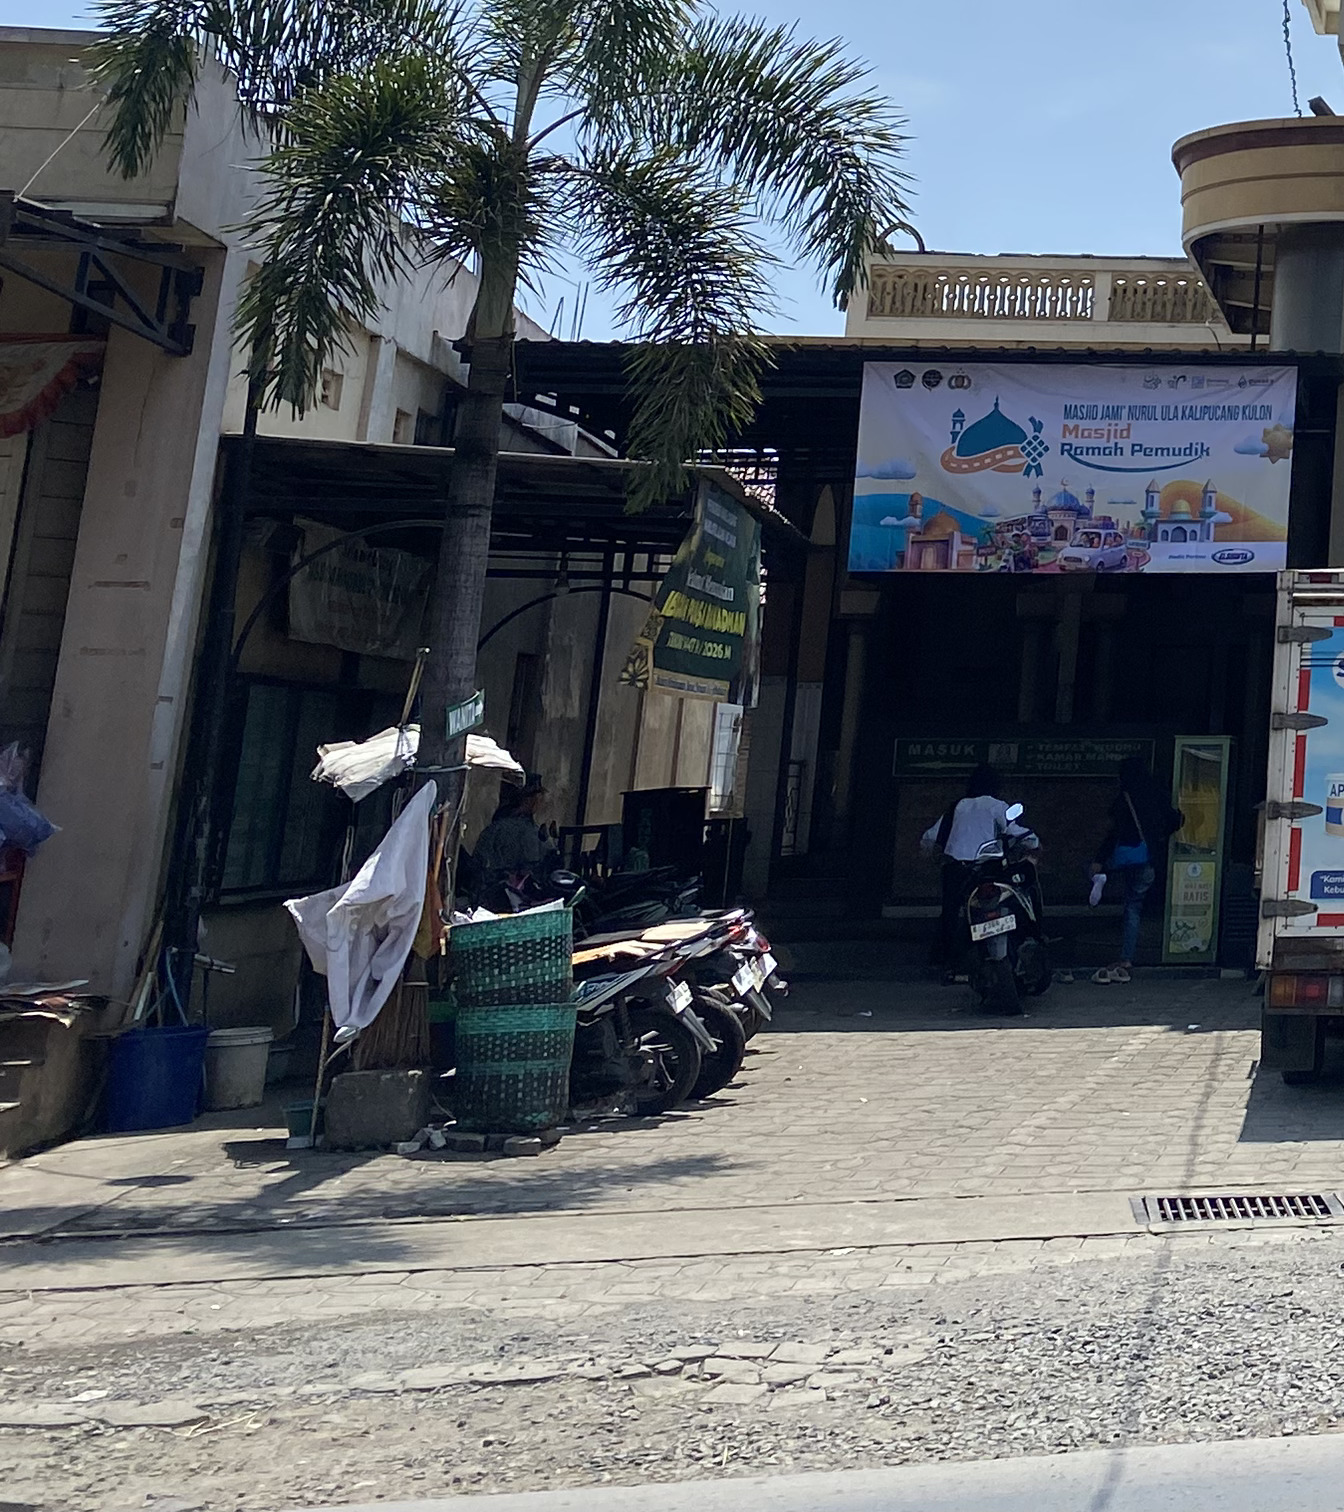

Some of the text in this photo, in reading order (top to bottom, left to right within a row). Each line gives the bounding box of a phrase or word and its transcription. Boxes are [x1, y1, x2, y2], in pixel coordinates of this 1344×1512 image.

[1063, 404, 1098, 420] MASJID
[1127, 404, 1159, 420] NURUL
[1160, 404, 1178, 420] ULA
[1180, 404, 1239, 421] KALIPUCANG
[1240, 404, 1273, 421] KULON
[1061, 423, 1132, 443] Masjid
[1060, 442, 1211, 457] Ramah Pemudik
[908, 743, 976, 756] MASUK
